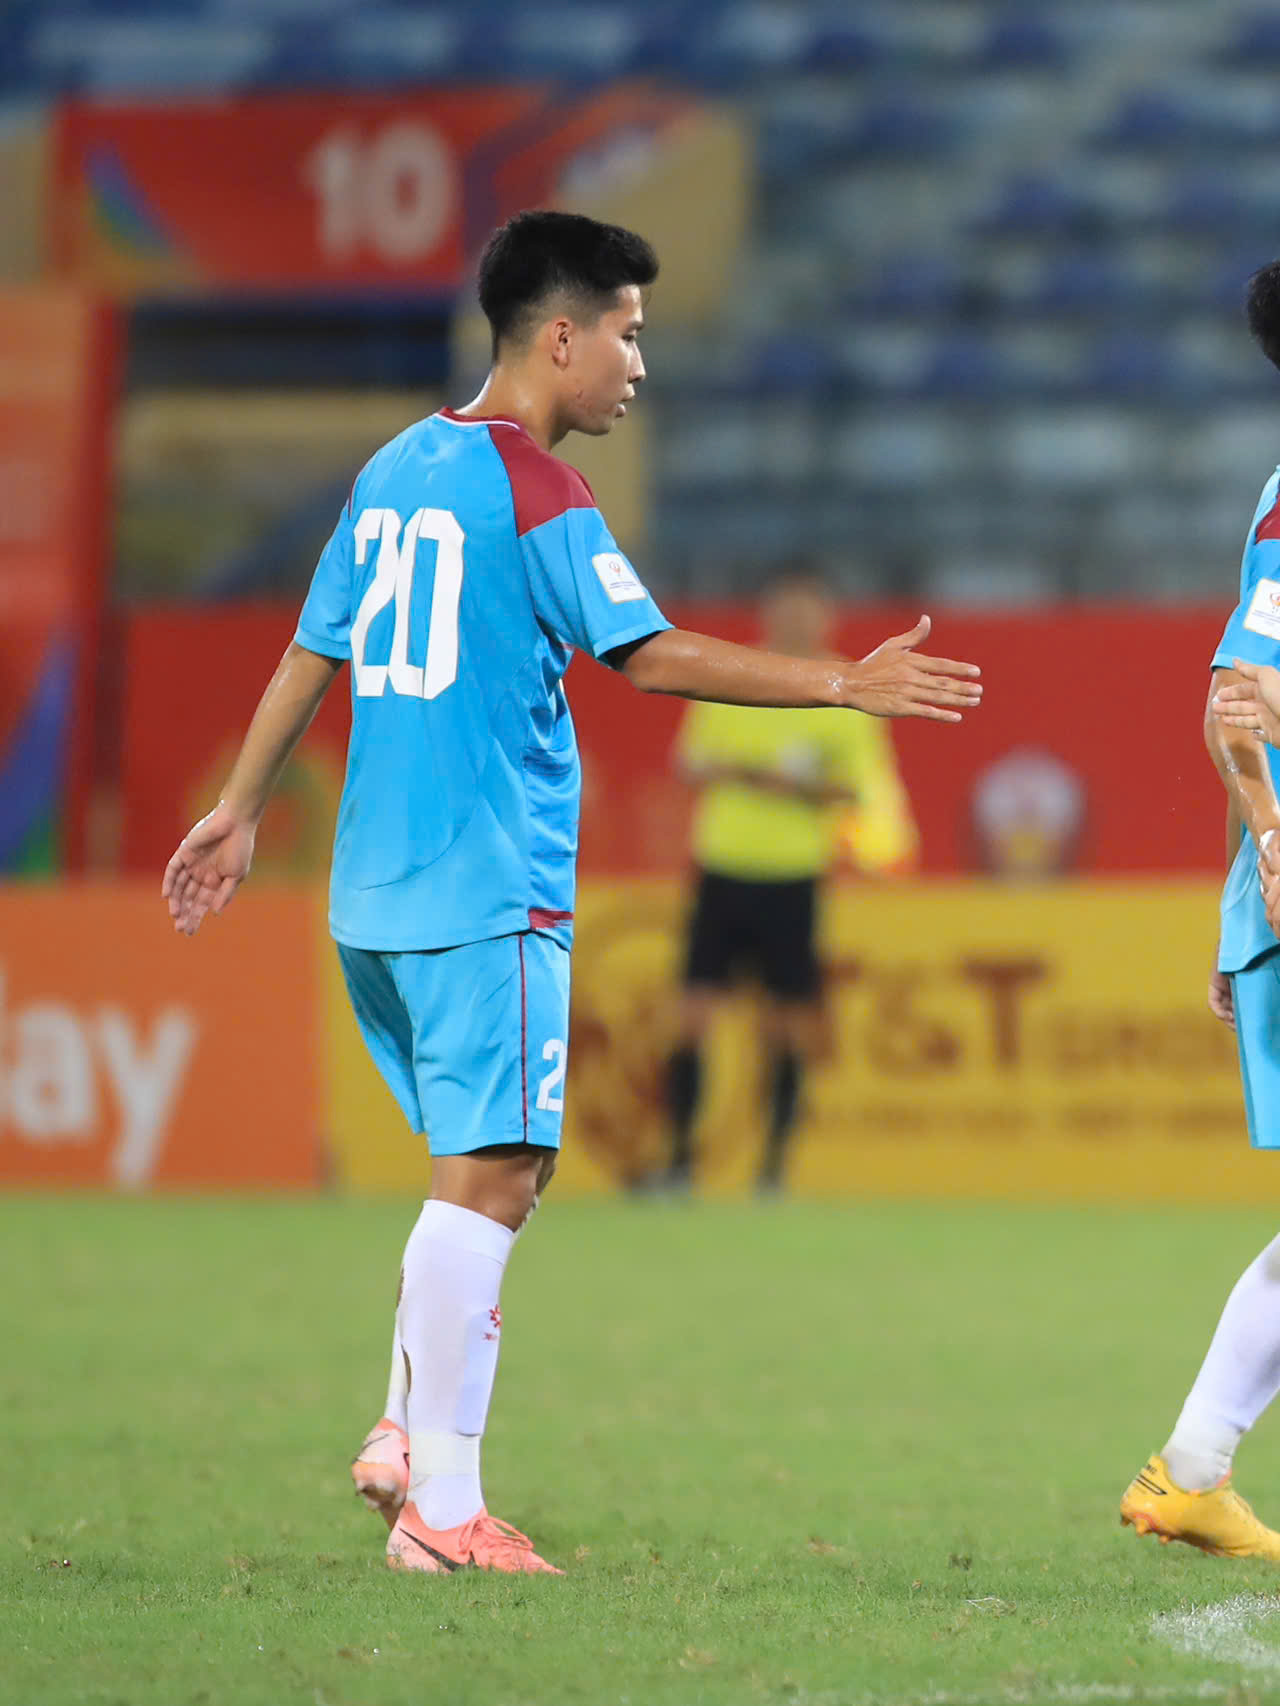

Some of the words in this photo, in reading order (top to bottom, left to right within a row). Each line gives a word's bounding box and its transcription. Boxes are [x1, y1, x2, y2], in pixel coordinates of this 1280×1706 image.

[312, 122, 458, 261] 10
[352, 508, 465, 700] 20
[0, 960, 196, 1186] ay
[536, 1038, 568, 1112] 2
